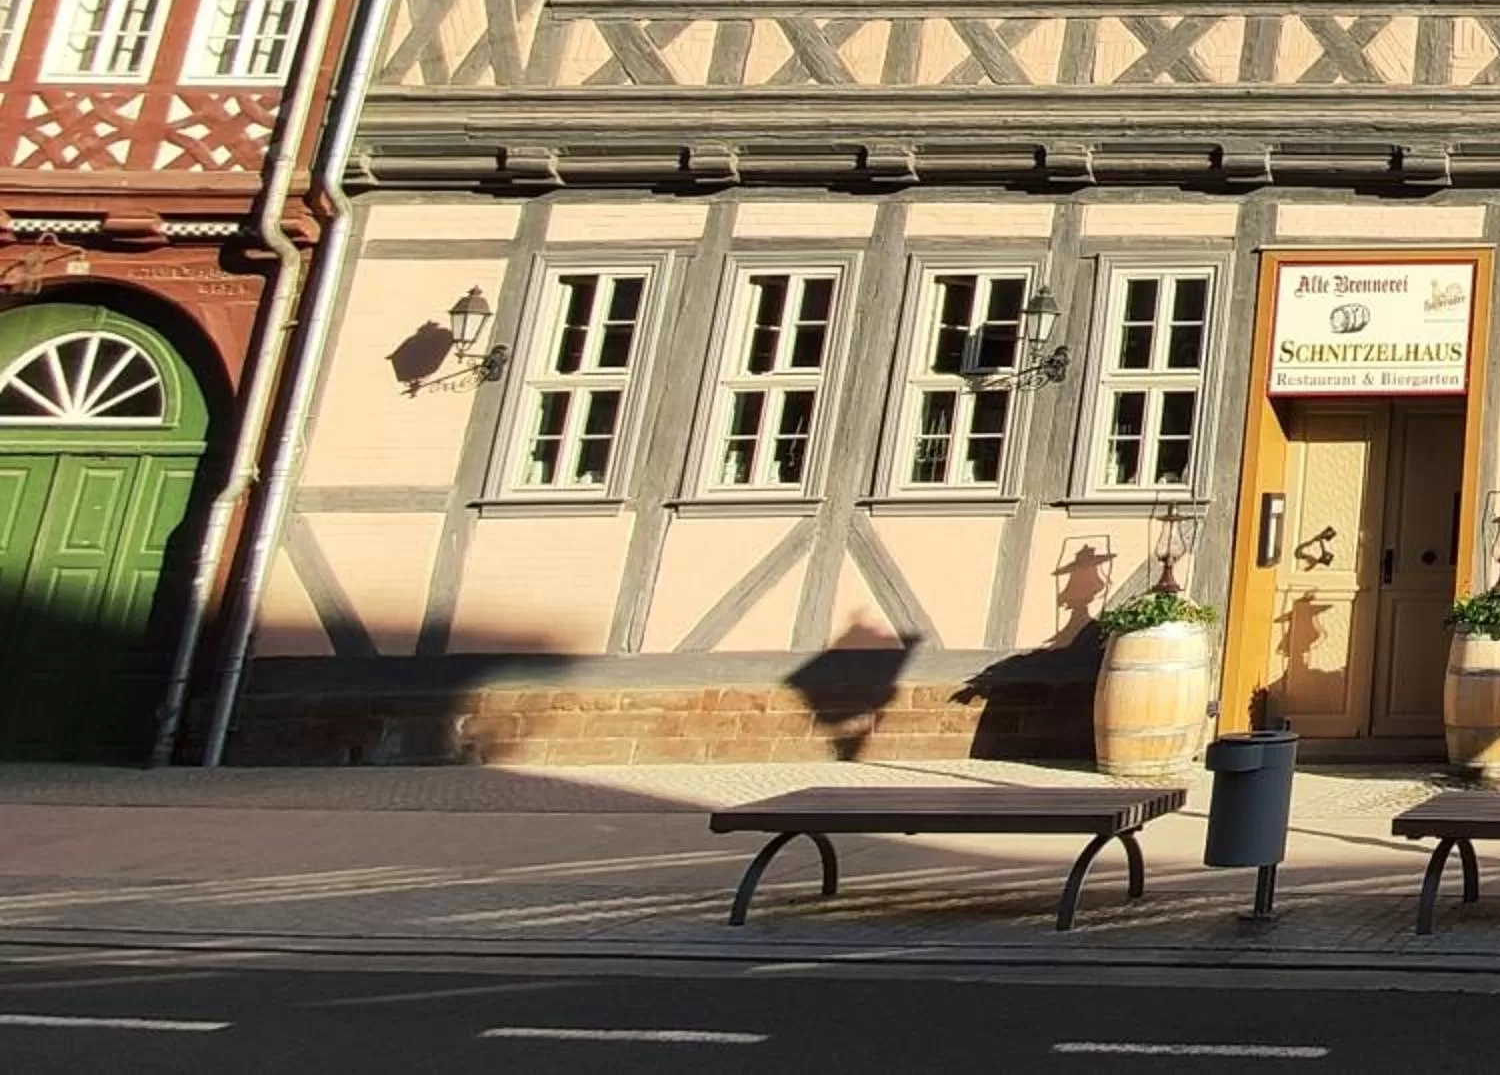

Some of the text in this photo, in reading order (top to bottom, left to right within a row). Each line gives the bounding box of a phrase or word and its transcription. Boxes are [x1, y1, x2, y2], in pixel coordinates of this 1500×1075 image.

[1294, 274, 1408, 298] Alte Brennerei
[1276, 371, 1460, 388] Restaurant & Biergarten
